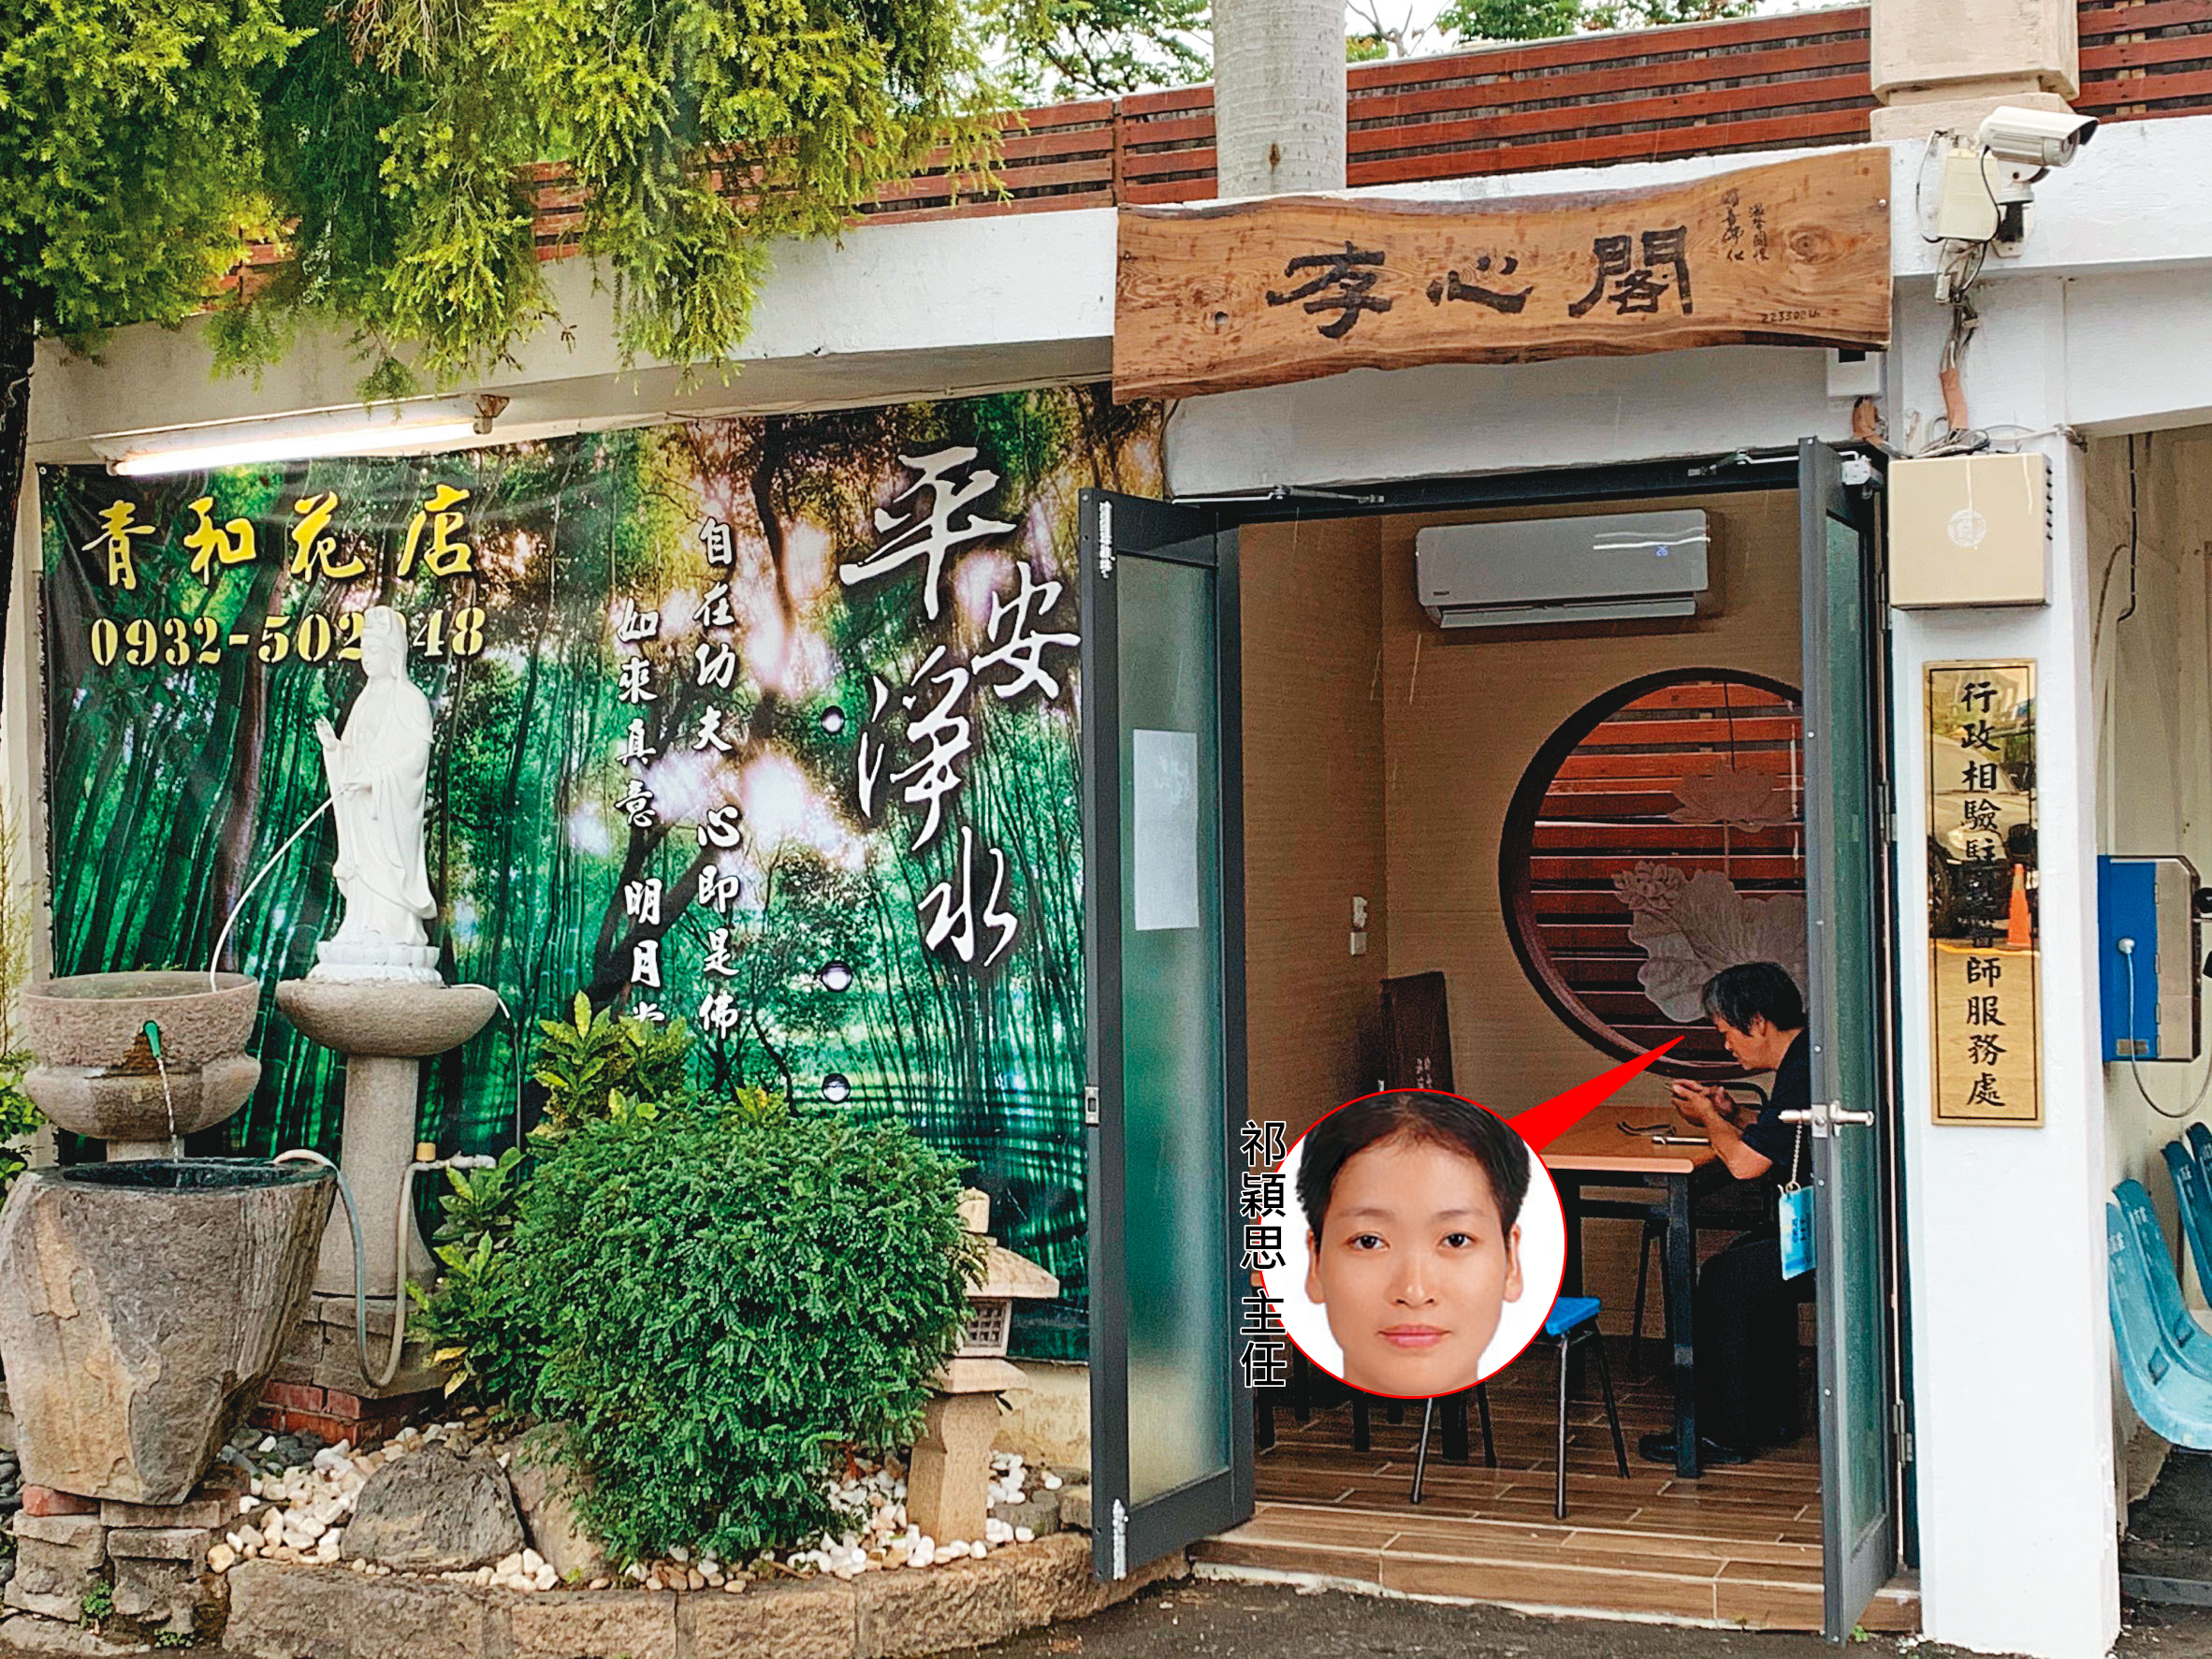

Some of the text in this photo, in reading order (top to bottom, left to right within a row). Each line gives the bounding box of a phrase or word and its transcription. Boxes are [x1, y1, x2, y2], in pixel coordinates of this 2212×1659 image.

[82, 484, 473, 590] 青和花店
[91, 606, 487, 666] 0932-50248
[615, 597, 659, 828] 如來真意
[693, 517, 741, 1040] 自在功夫 心即是佛
[839, 445, 1082, 968] 平安淨水
[1960, 681, 2007, 1107] 行政相驗駐師服務處
